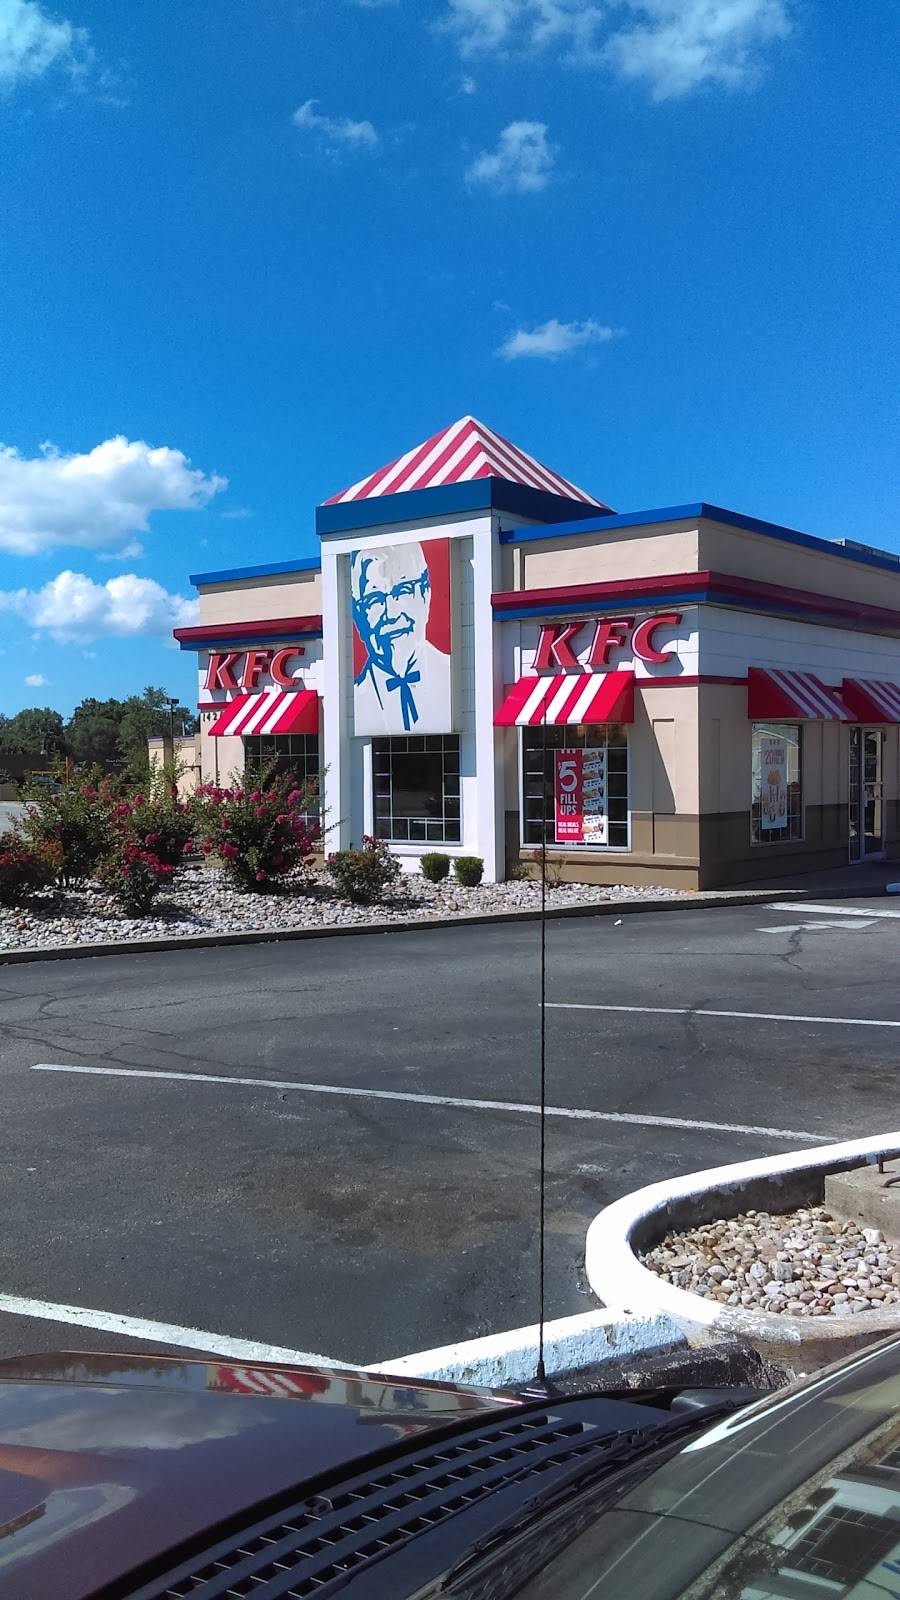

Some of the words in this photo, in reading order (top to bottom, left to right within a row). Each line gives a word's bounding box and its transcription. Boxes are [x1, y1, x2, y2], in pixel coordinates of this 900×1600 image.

[531, 612, 682, 669] KFC
[203, 647, 305, 690] KFC
[560, 794, 577, 805] FILL
[560, 805, 577, 816] UPS
